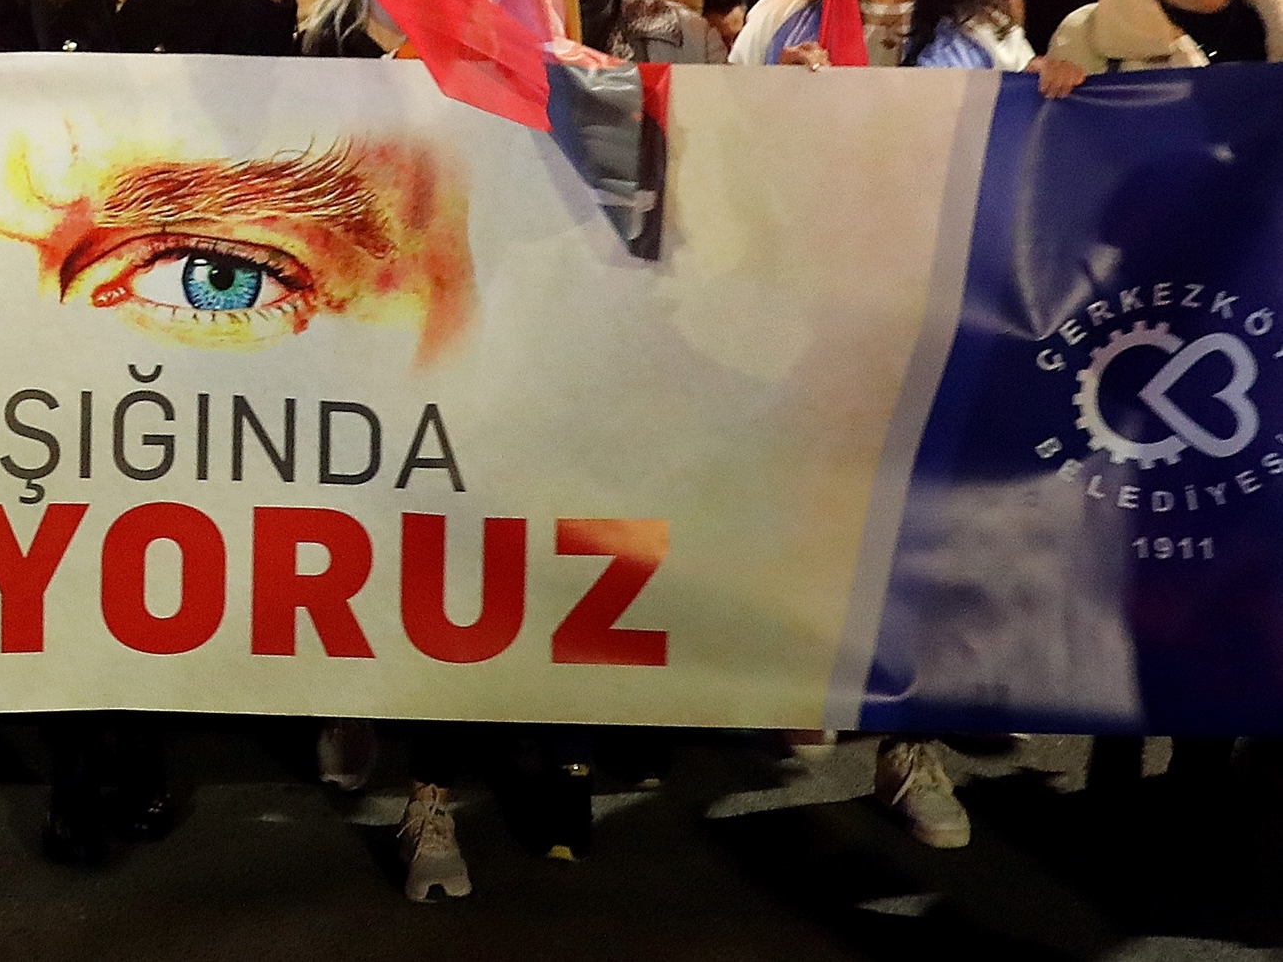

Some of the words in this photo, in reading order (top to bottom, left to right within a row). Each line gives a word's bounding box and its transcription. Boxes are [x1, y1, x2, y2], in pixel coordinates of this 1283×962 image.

[1036, 282, 1283, 372] ÇERKEZKÖ
[1034, 434, 1283, 513] BELEDİYES
[1131, 537, 1216, 560] 1911
